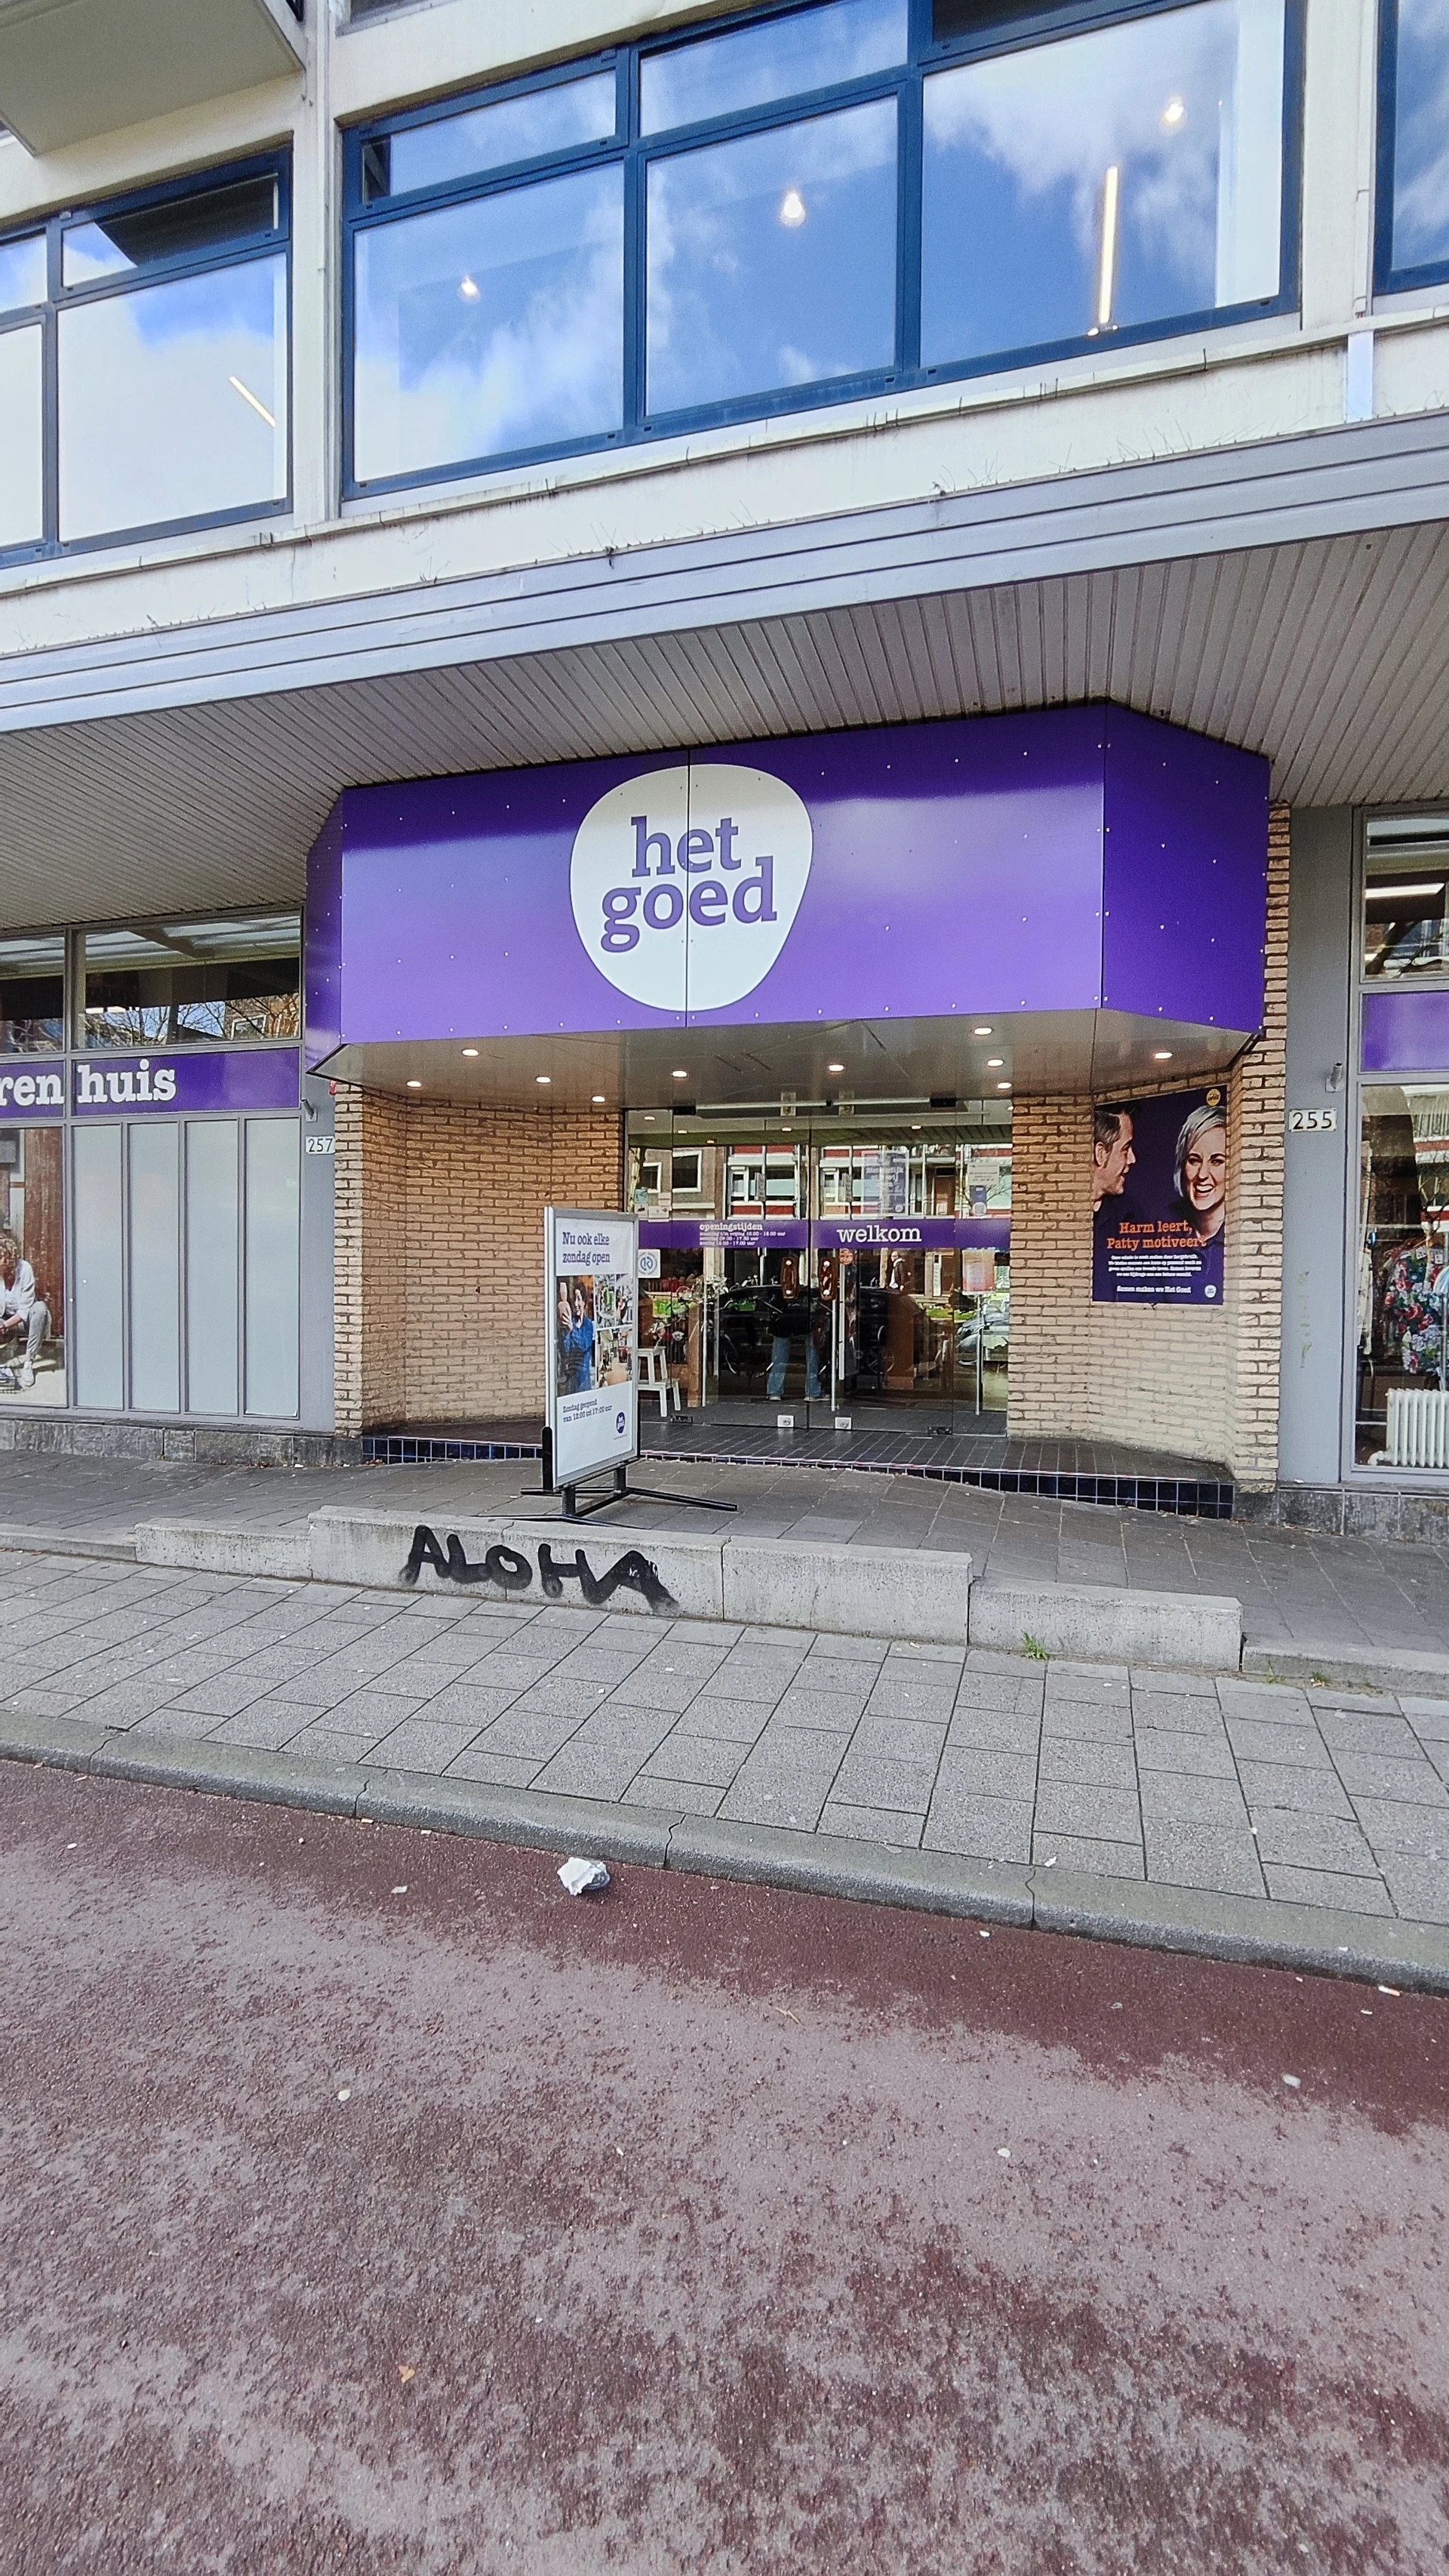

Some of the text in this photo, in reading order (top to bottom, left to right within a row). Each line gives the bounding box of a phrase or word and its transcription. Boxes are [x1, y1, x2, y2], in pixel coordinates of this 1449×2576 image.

[631, 815, 741, 878] het
[601, 855, 777, 953] goed
[78, 1058, 176, 1103] huis
[1293, 1111, 1332, 1130] 255
[308, 1138, 333, 1152] 257
[699, 1223, 763, 1232] openingstijden
[836, 1225, 922, 1243] welkom
[1119, 1220, 1192, 1234] Harm leert,
[562, 1232, 610, 1245] Nu ook elke
[1106, 1235, 1207, 1251] Patty motiveert
[562, 1251, 610, 1266] zondag open
[592, 1406, 605, 1414] 17:00
[398, 1525, 678, 1617] ALOHA
